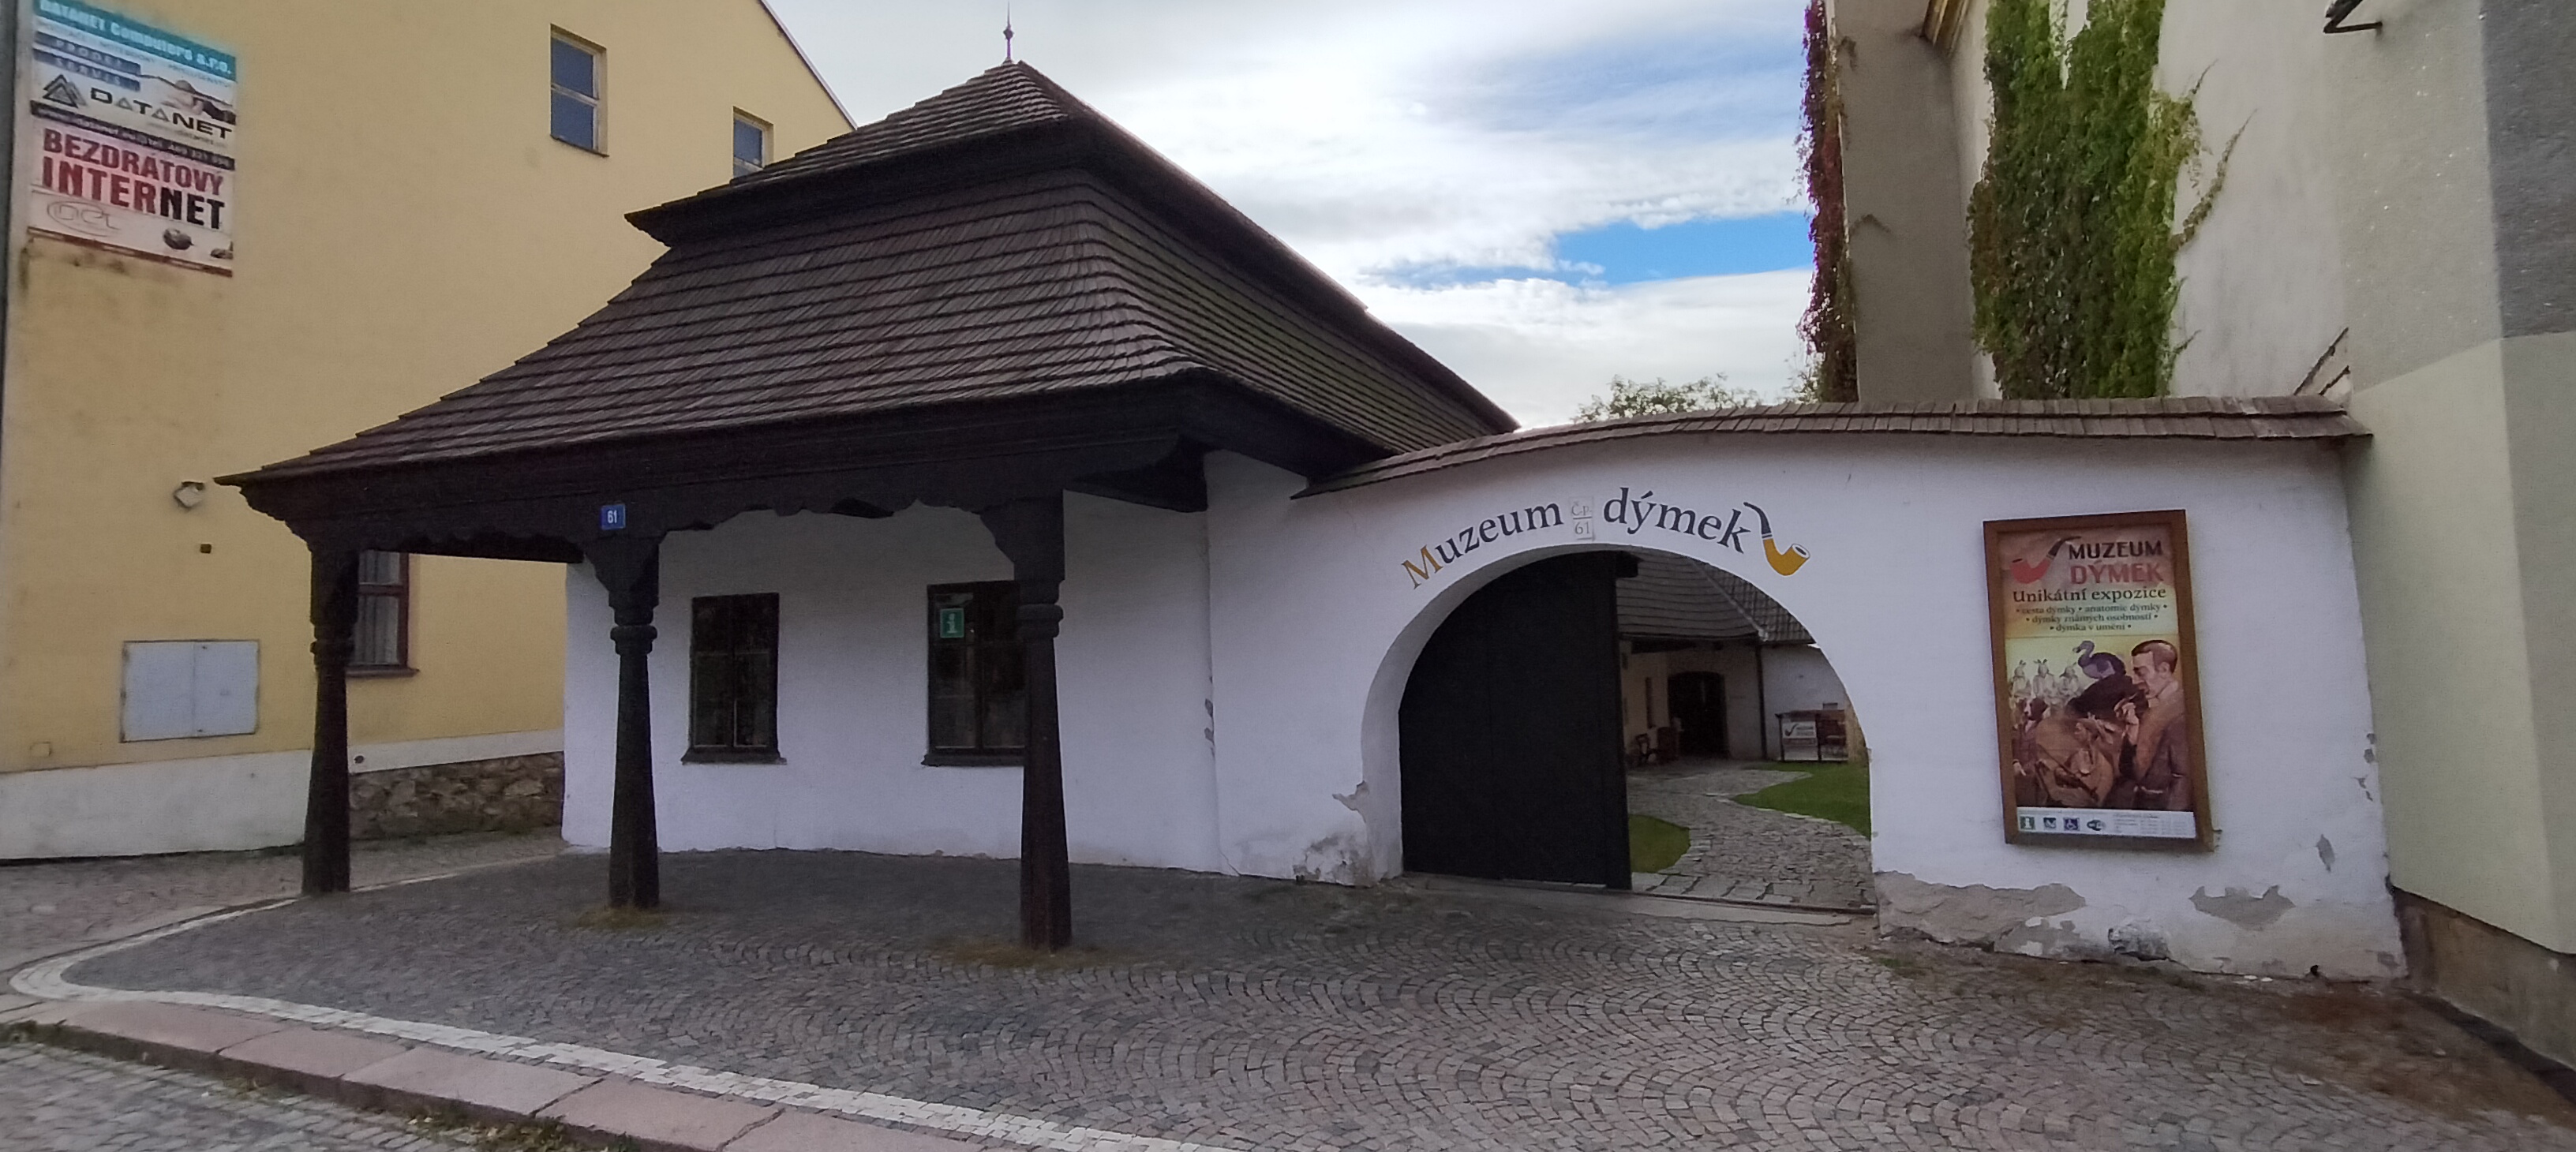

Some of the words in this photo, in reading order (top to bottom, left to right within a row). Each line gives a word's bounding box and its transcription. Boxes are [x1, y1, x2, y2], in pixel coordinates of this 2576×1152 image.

[42, 156, 226, 230] INTERNET
[608, 510, 617, 524] 61
[1574, 521, 1589, 535] 61
[1401, 499, 1564, 589] Muzeum
[1603, 488, 1750, 554] dýmek
[2069, 540, 2163, 560] MUZEUM
[2070, 559, 2165, 585] DÝMEK
[2013, 588, 2087, 603] Unikátní
[2091, 585, 2166, 603] expozice
